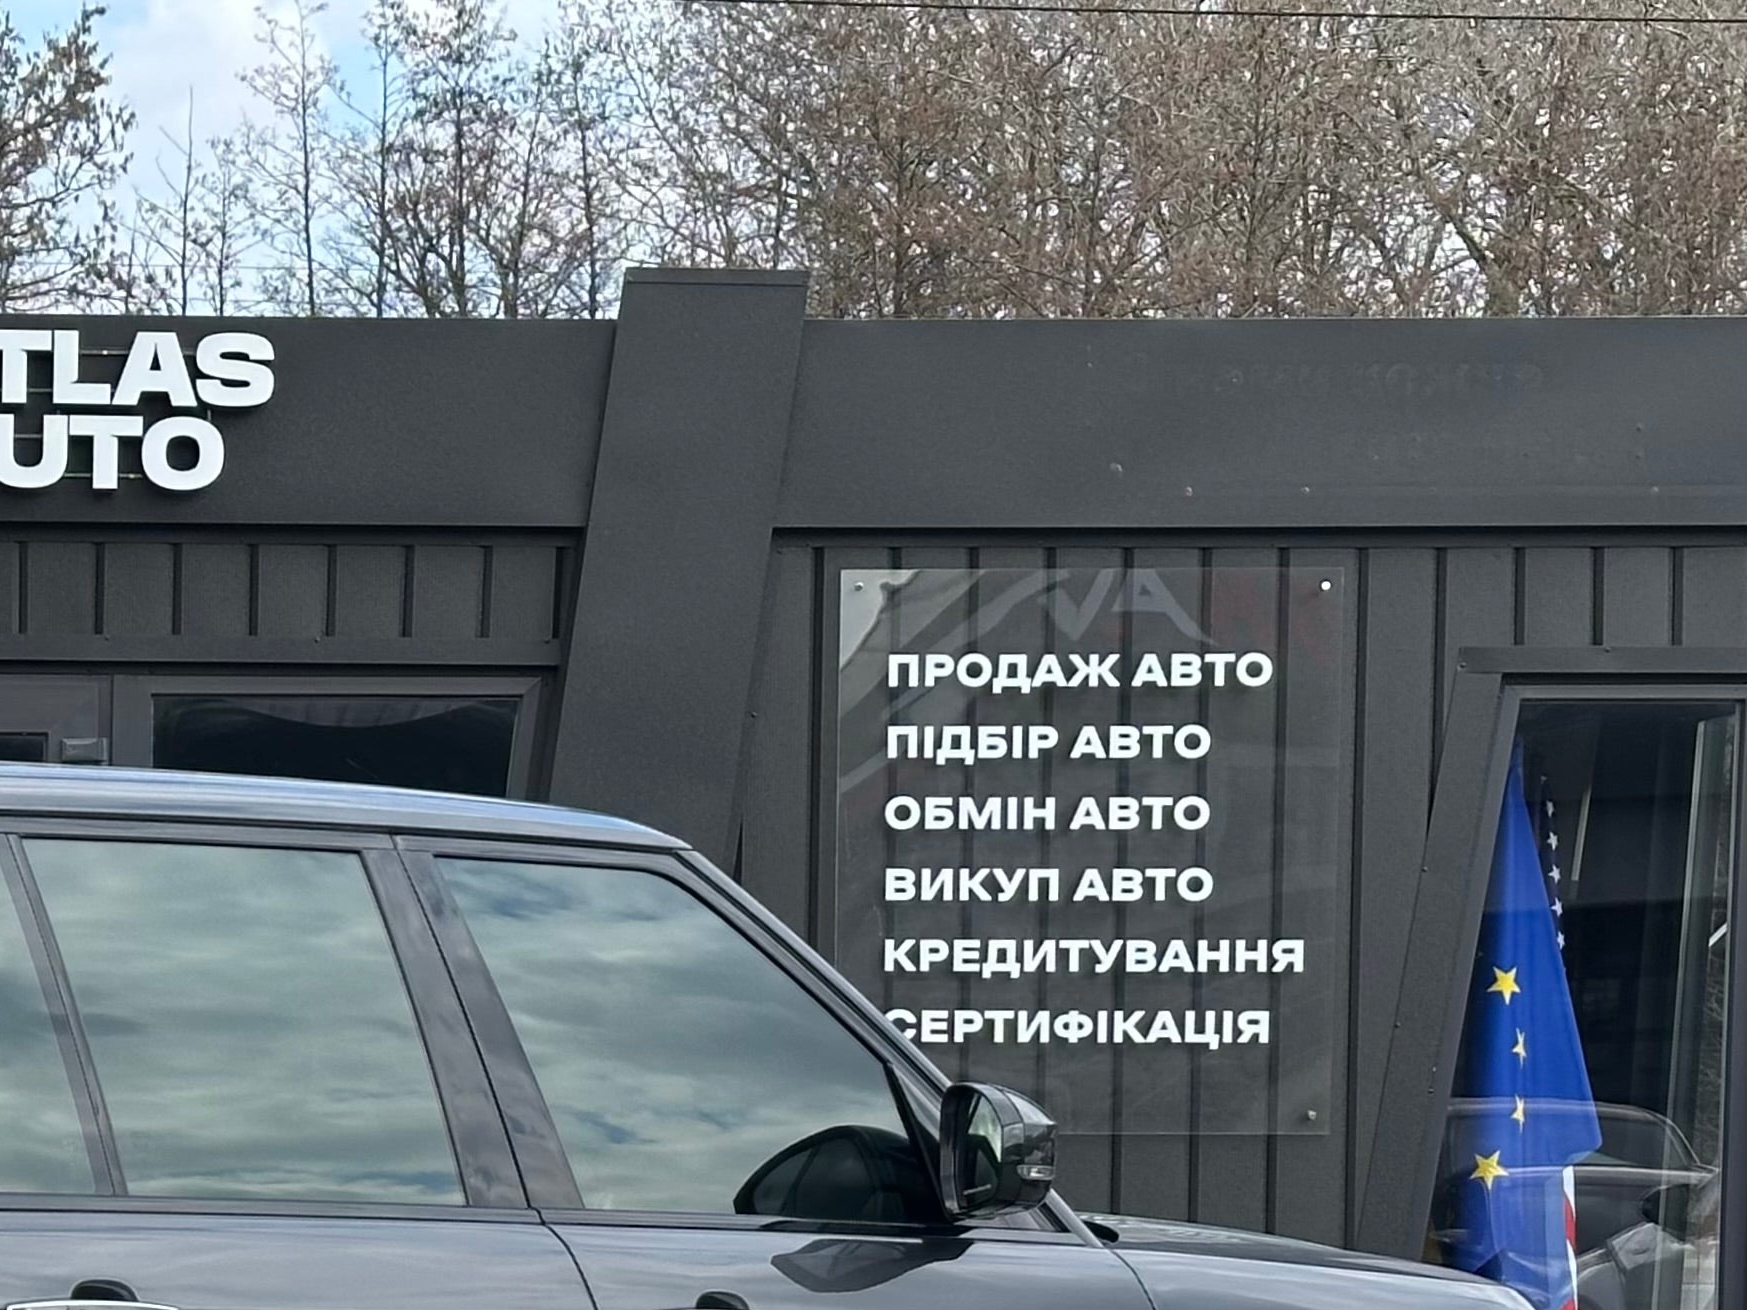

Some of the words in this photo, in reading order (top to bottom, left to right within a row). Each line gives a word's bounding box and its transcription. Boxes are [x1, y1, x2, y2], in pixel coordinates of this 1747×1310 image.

[888, 653, 1120, 694] ПРОДАЖ
[1132, 652, 1274, 687] АВТО
[887, 725, 1059, 766] ПІДБІР
[1070, 724, 1211, 759] АВТО
[884, 795, 1056, 830] ОБМІН
[1069, 795, 1211, 831] АВТО
[884, 867, 1060, 902] ВИКУП
[1072, 867, 1214, 902] АВТО
[884, 938, 1305, 979] КРЕДИТУВАННЯ
[885, 1009, 1270, 1049] СЕРТИФІКАЦІЯ
